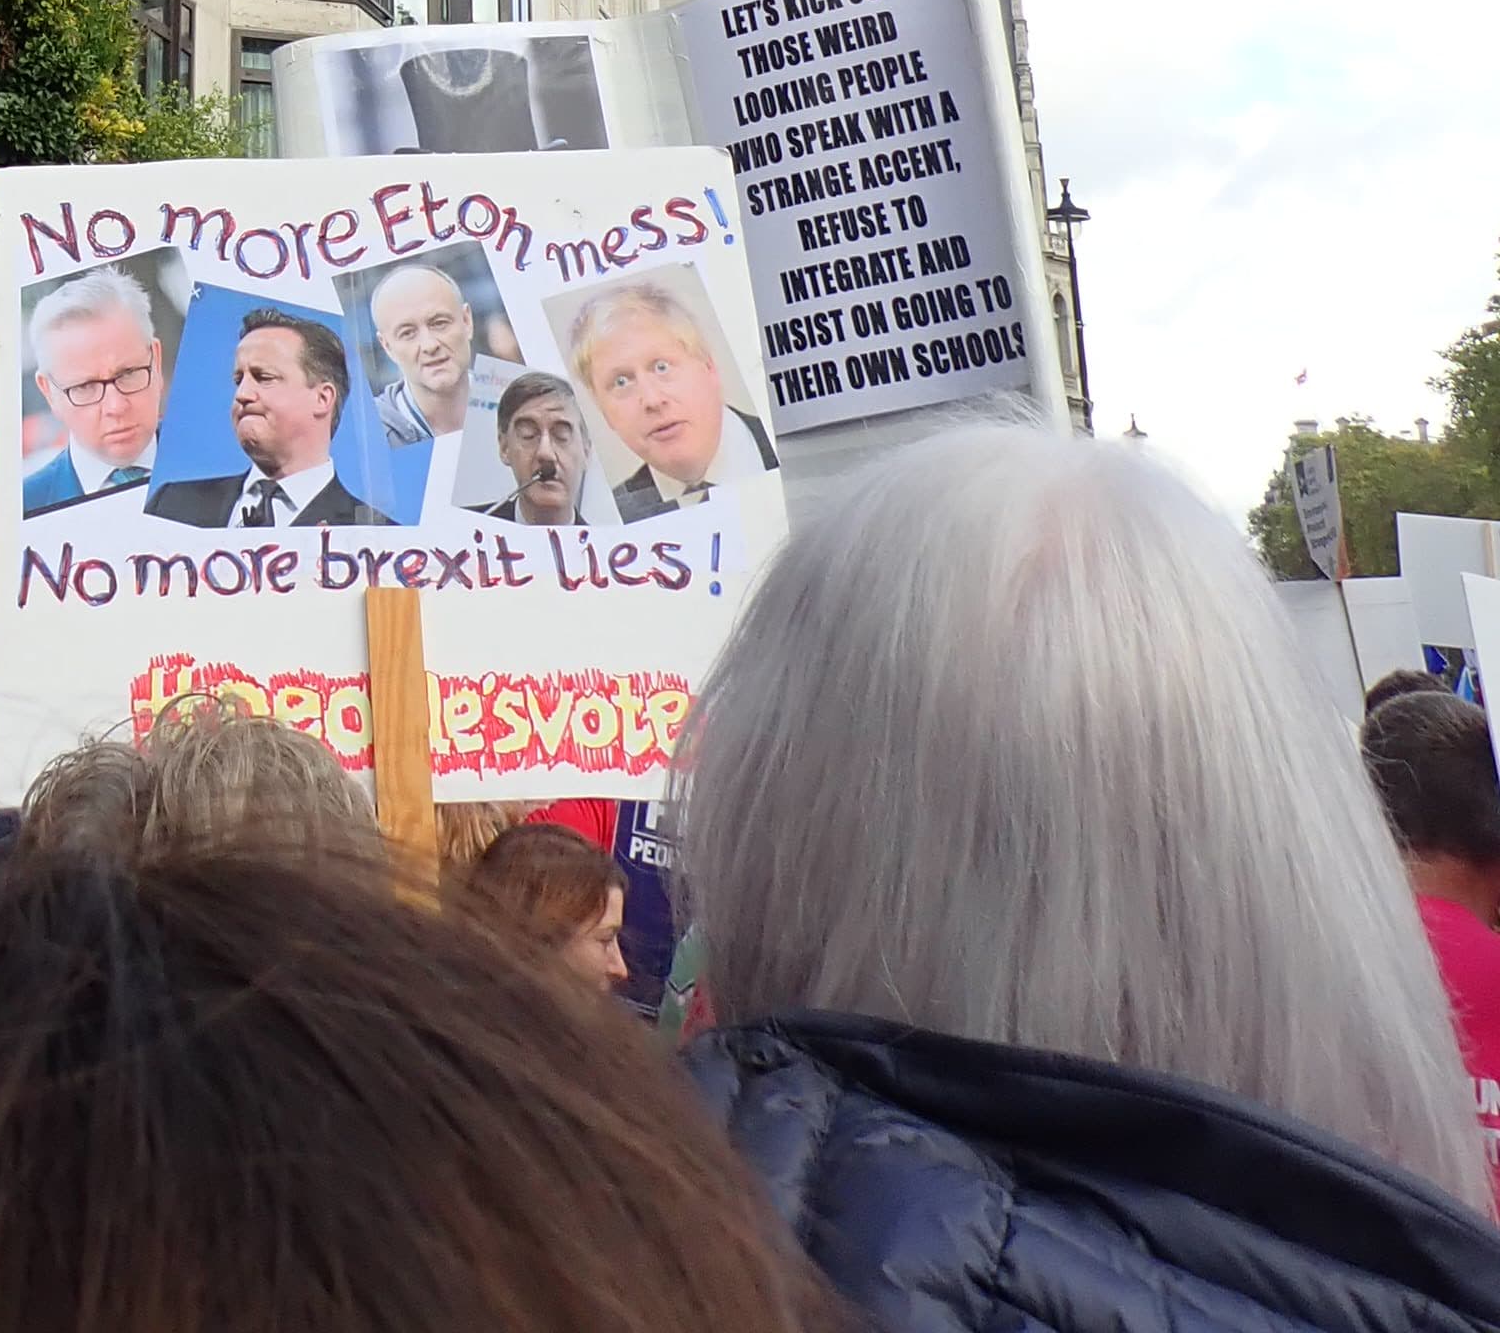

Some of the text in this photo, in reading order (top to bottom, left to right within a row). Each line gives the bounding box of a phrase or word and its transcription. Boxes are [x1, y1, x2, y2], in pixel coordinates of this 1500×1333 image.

[737, 10, 898, 79] THOSE WEIRD
[733, 49, 928, 127] LOOKING PEOPLE
[726, 89, 960, 176] WHO SPEAK WITH A
[746, 138, 962, 216] STRANGE ACCENT,
[20, 202, 136, 275] No
[160, 202, 367, 281] more
[369, 179, 534, 273] Eton
[797, 193, 929, 251] REFUSE TO
[780, 234, 972, 305] INTEGRATE AND
[764, 274, 1013, 358] INSIST ON GOING TO
[770, 321, 1026, 406] THEIR OWN SCHOOLS
[18, 541, 117, 610] No
[126, 538, 298, 596] more
[320, 530, 532, 593] brexit
